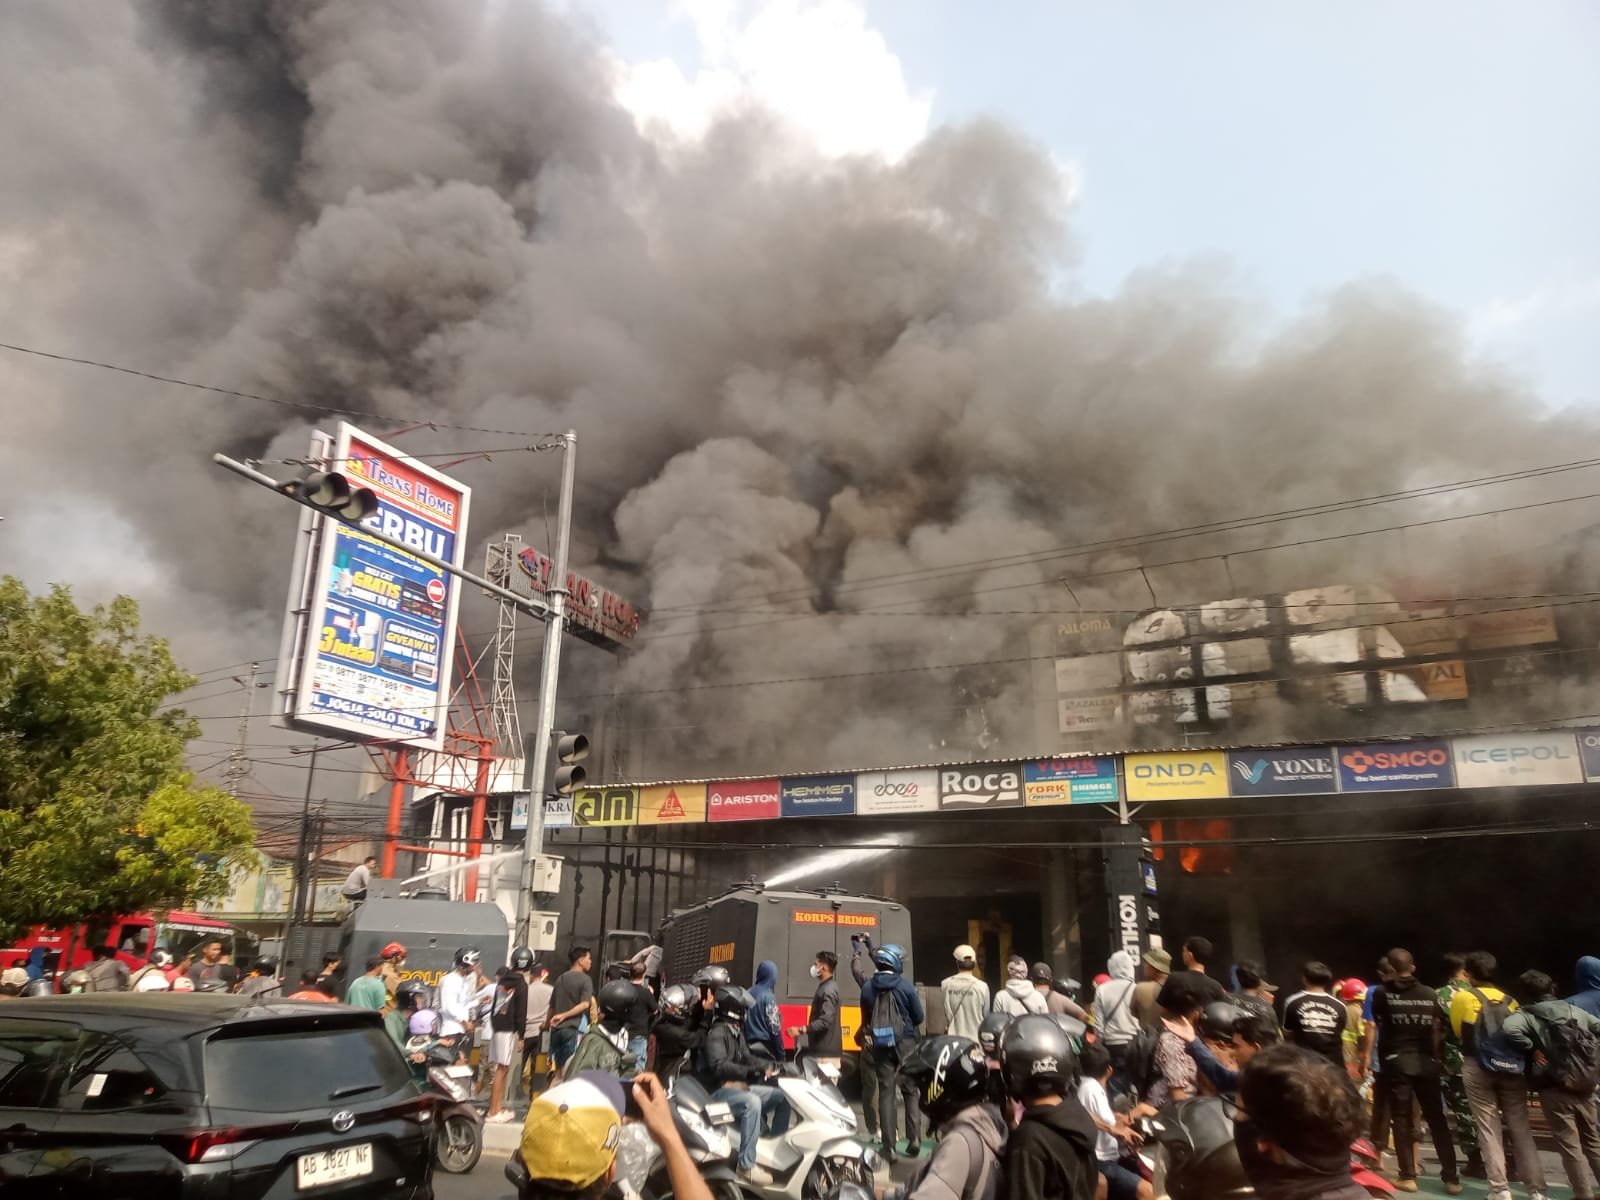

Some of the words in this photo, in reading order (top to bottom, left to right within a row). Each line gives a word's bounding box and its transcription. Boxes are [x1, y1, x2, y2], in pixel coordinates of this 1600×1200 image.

[368, 456, 412, 496] TRANS
[416, 480, 454, 516] HOME
[361, 507, 446, 560] ERBU
[352, 571, 402, 600] GRATIS
[1058, 619, 1112, 636] PALOMA
[319, 626, 337, 652] 3
[386, 632, 437, 653] GIVEAWAY
[1374, 750, 1447, 769] SMCO
[1463, 746, 1571, 764] ICEPOL
[1134, 762, 1216, 779] ONDA
[1272, 758, 1332, 775] VONE
[942, 770, 1018, 793] Roca
[1026, 784, 1065, 794] YORK
[1072, 783, 1112, 792] SHIMGE
[724, 794, 778, 805] ARISTON
[795, 911, 834, 923] KORPS
[837, 914, 876, 926] BRIMOB
[709, 942, 736, 964] BRIMOB
[304, 1156, 317, 1175] AB
[356, 1145, 369, 1165] NF
